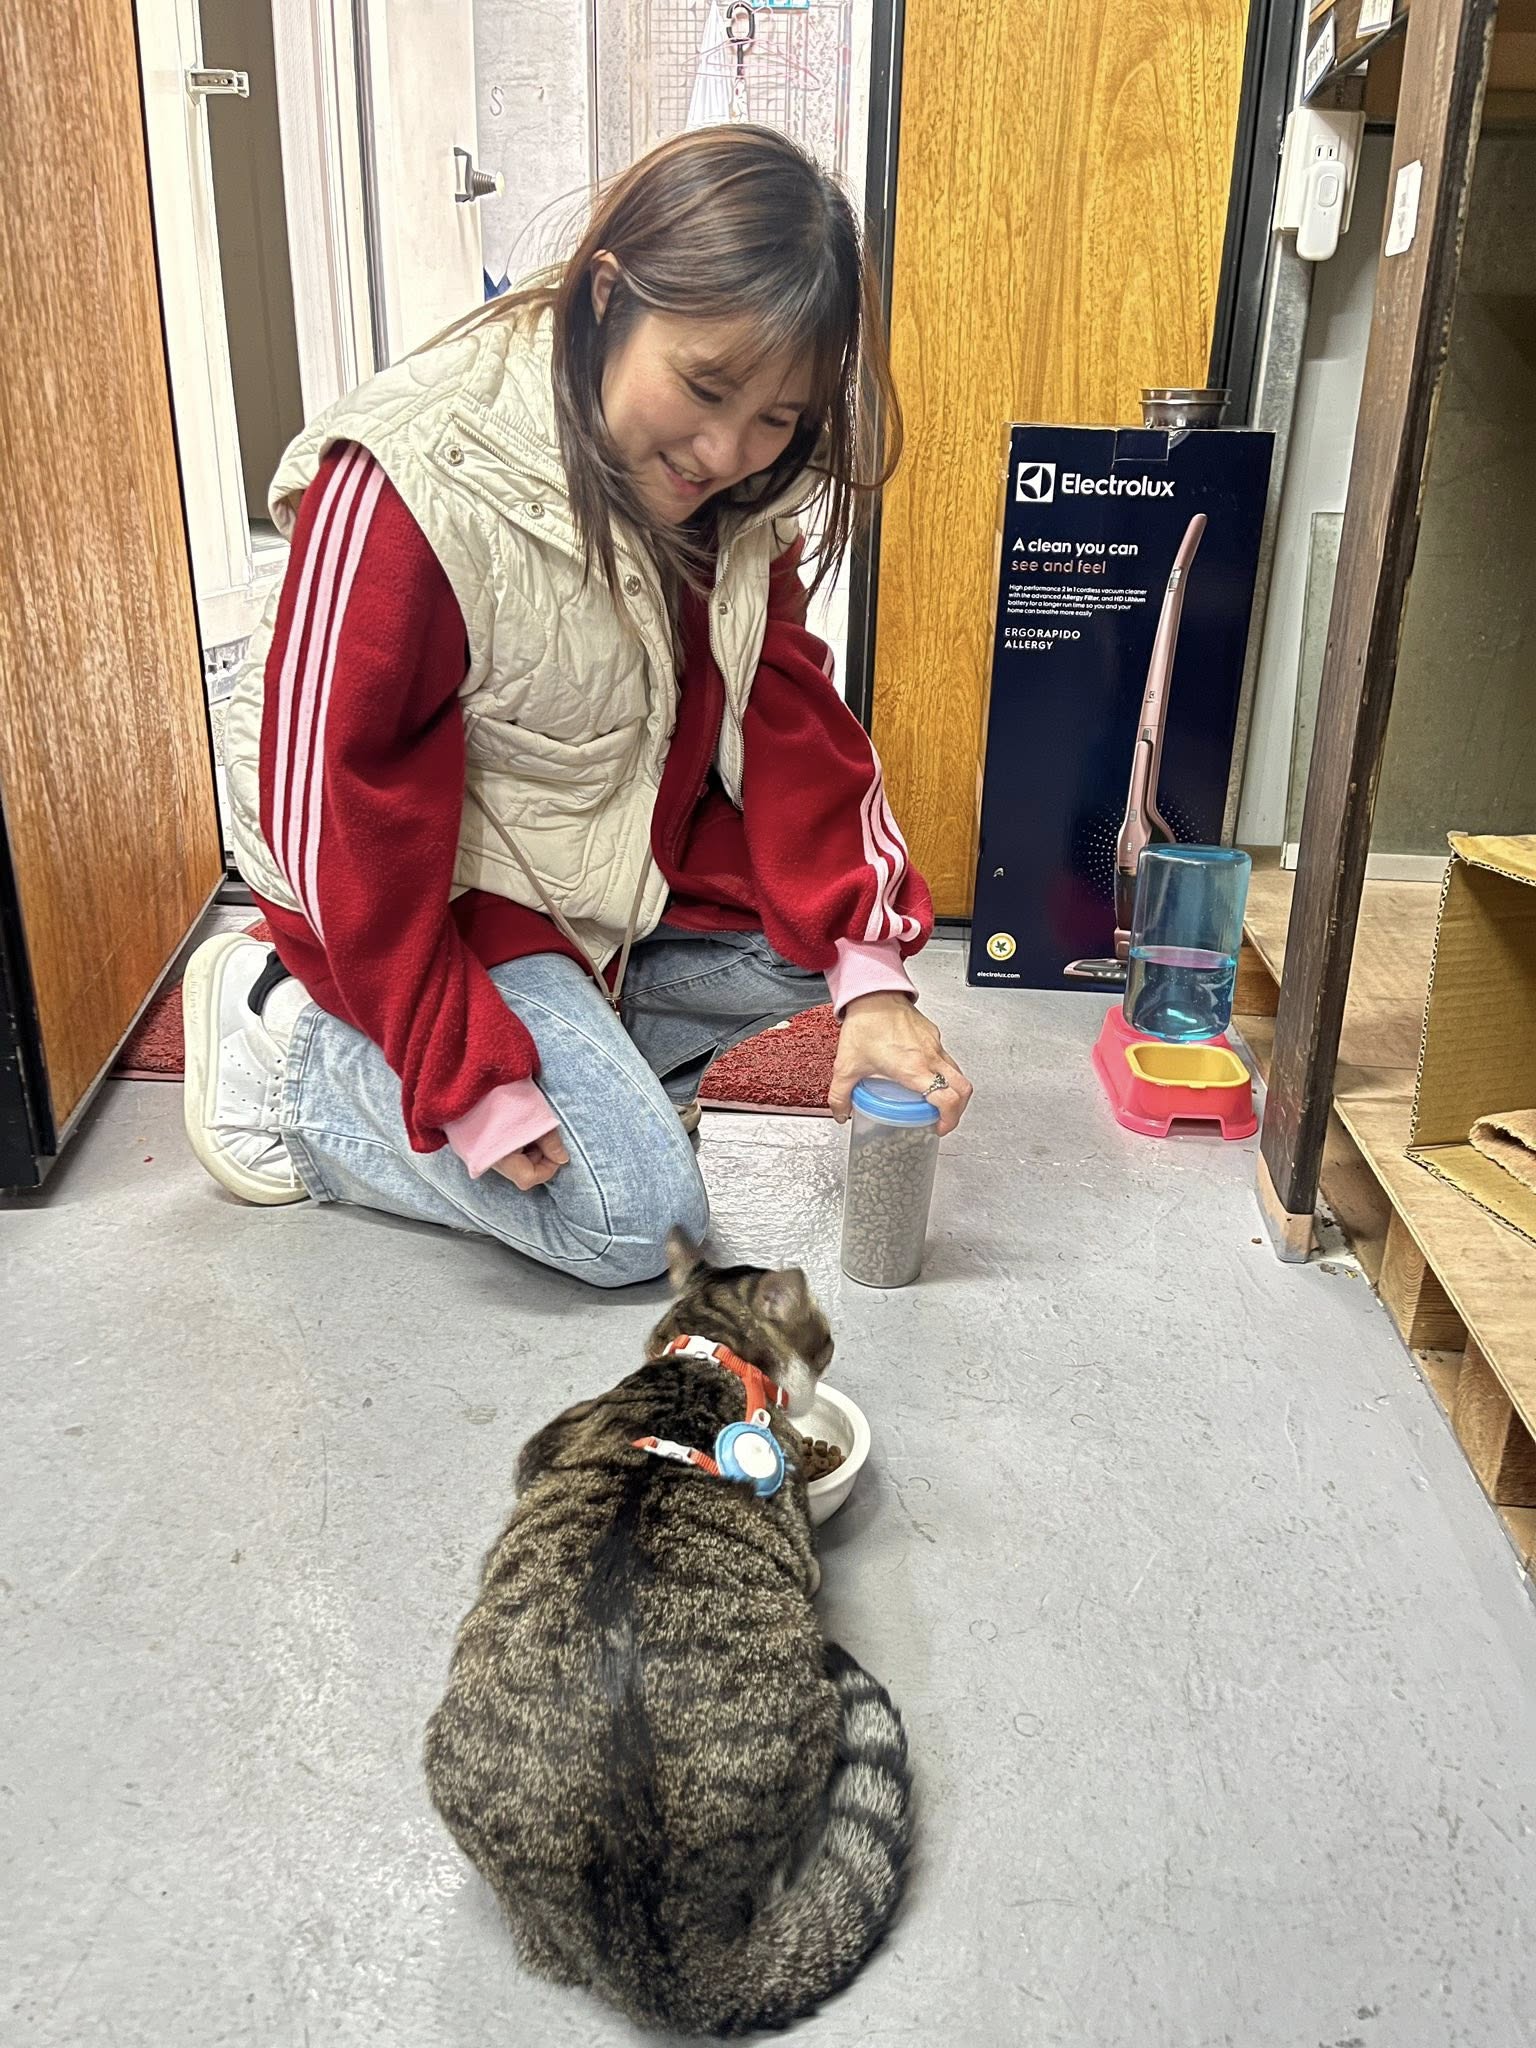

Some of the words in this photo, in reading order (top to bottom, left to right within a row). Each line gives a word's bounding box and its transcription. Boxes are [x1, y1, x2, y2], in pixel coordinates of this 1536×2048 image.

[1061, 473, 1175, 497] Electrolux
[1012, 537, 1025, 551] A
[1028, 538, 1072, 553] clean
[1076, 542, 1105, 557] you
[1108, 544, 1139, 555] can
[1011, 560, 1039, 571] see
[1043, 560, 1073, 573] and
[1077, 560, 1106, 574] feel
[1004, 628, 1081, 639] ERGORAPIDO
[1004, 640, 1054, 650] ALLERGY
